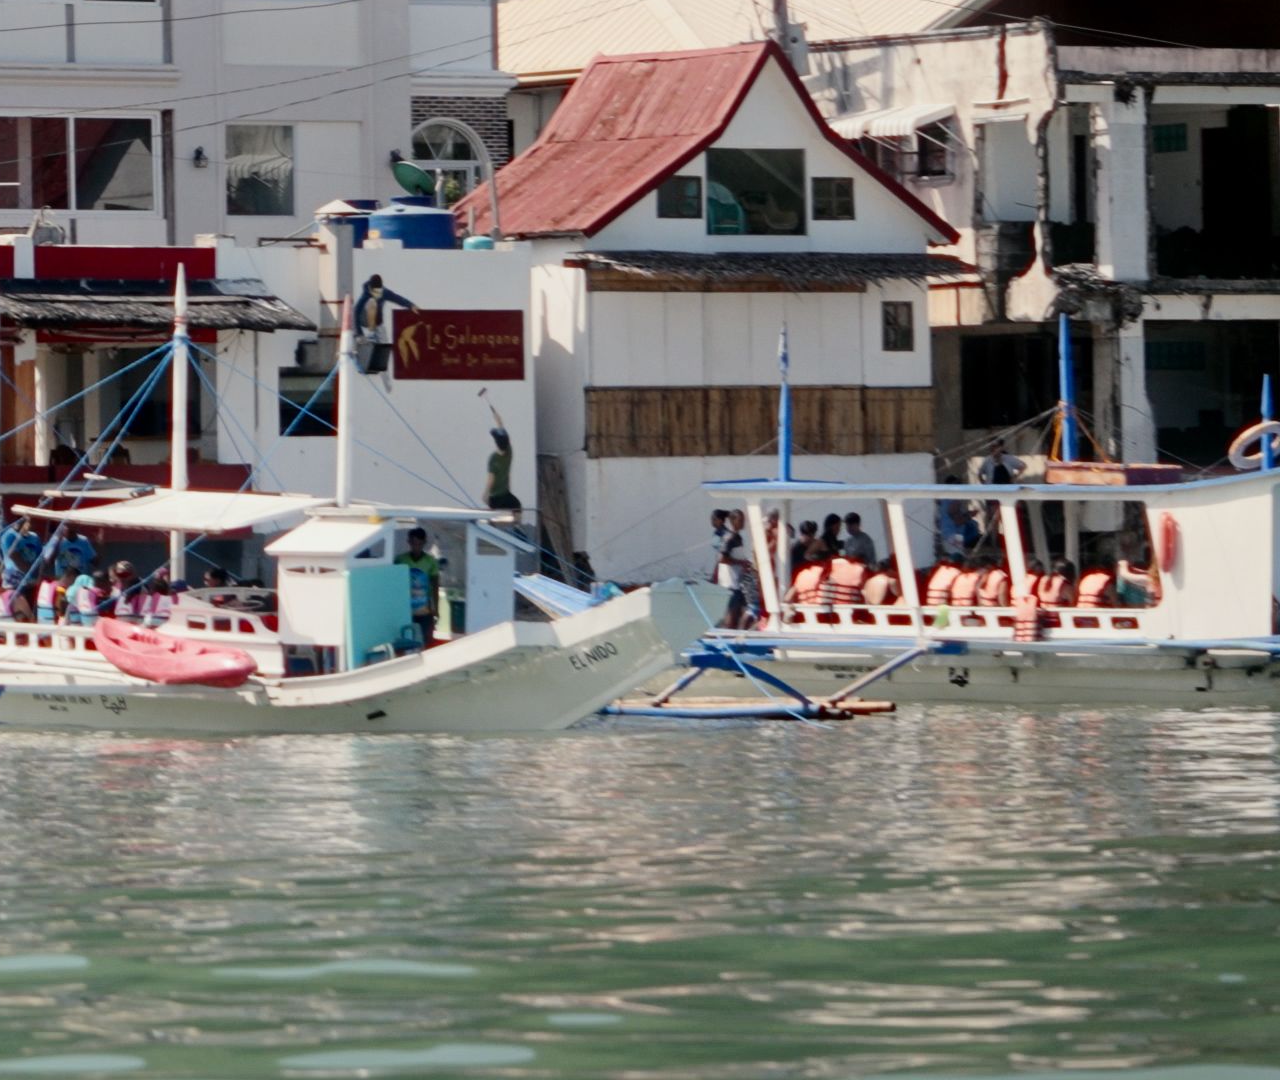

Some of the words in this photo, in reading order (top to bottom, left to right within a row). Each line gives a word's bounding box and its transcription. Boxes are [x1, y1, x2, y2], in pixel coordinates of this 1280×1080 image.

[425, 324, 440, 350] La
[568, 654, 587, 670] EL
[583, 641, 618, 665] NIDO
